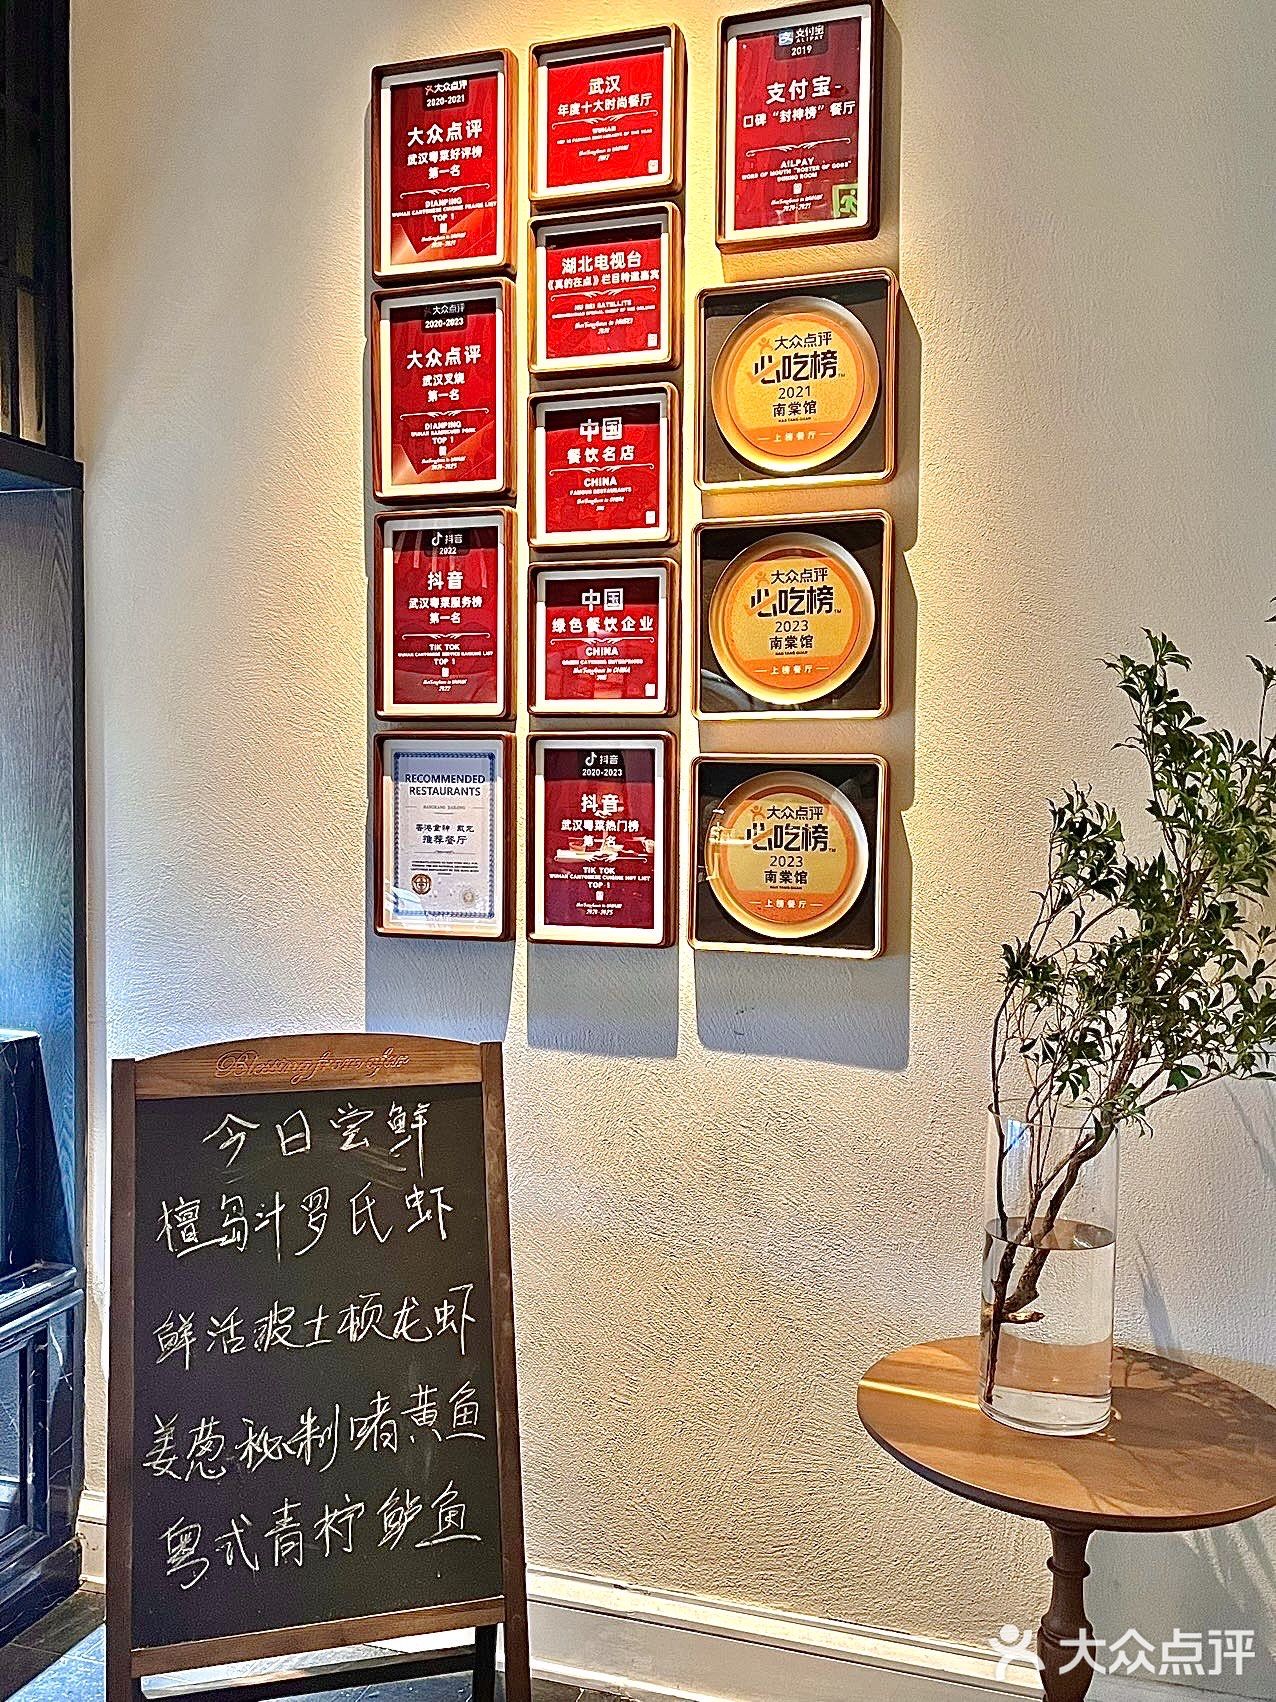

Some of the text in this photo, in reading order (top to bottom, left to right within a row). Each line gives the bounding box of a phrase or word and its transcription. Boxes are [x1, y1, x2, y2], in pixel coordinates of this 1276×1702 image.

[791, 45, 813, 56] 2019
[433, 79, 468, 94] 大众点评
[588, 75, 621, 96] 武汉
[765, 75, 832, 105] 支付宝
[426, 94, 465, 107] 2020-2021
[557, 92, 653, 117] 年度十大时尚餐厅
[407, 119, 483, 147] 大众点评
[407, 145, 483, 166] 武汉粤菜好评榜
[428, 164, 461, 180] 第一名
[432, 213, 448, 222] TOP
[561, 250, 642, 275] 湖北电视台
[432, 303, 465, 315] 大众点评
[774, 331, 832, 351] 大众点评
[406, 344, 482, 370] 大众点评
[754, 350, 838, 384] 必吃榜
[422, 371, 465, 387] 武汉叉烧
[427, 387, 460, 403] 第一名
[778, 385, 811, 399] 2021
[772, 400, 817, 417] 南棠馆
[579, 416, 623, 442] 中国
[773, 430, 817, 442] 上榜餐厅
[567, 445, 635, 464] 餐饮名店
[583, 476, 617, 487] CHINA
[444, 534, 463, 545] 抖音
[439, 546, 457, 555] 2022
[427, 570, 464, 590] 抖音
[770, 567, 828, 584] 大众点评
[408, 595, 483, 609] 武汉粤菜服务榜
[581, 587, 624, 612] 中国
[750, 585, 834, 617] 必吃榜
[429, 611, 461, 625] 第一名
[551, 615, 654, 634] 绿色餐饮企业
[775, 619, 809, 633] 2023
[428, 643, 460, 651] TIK TOK
[769, 634, 814, 650] 南棠馆
[585, 646, 619, 657] CHINA
[433, 658, 449, 666] TOP
[770, 664, 814, 675] 上榜餐厅
[599, 754, 619, 765] 抖音
[404, 773, 486, 784] RECOMMENDED
[582, 768, 623, 777] 2020-2023
[409, 786, 481, 797] RESTAURANTS
[580, 793, 620, 813] 抖音
[766, 805, 824, 821] 大众点评
[560, 819, 640, 833] 武汉粤菜热门榜
[422, 834, 468, 845] 推荐餐厅
[746, 822, 829, 852] 必吃榜
[769, 855, 803, 868] 2023
[582, 866, 597, 874] TIK
[764, 870, 808, 885] 南棠馆
[587, 881, 603, 889] TOP
[765, 899, 807, 909] 上榜餐厅
[201, 1101, 430, 1178] 今日尝鲜
